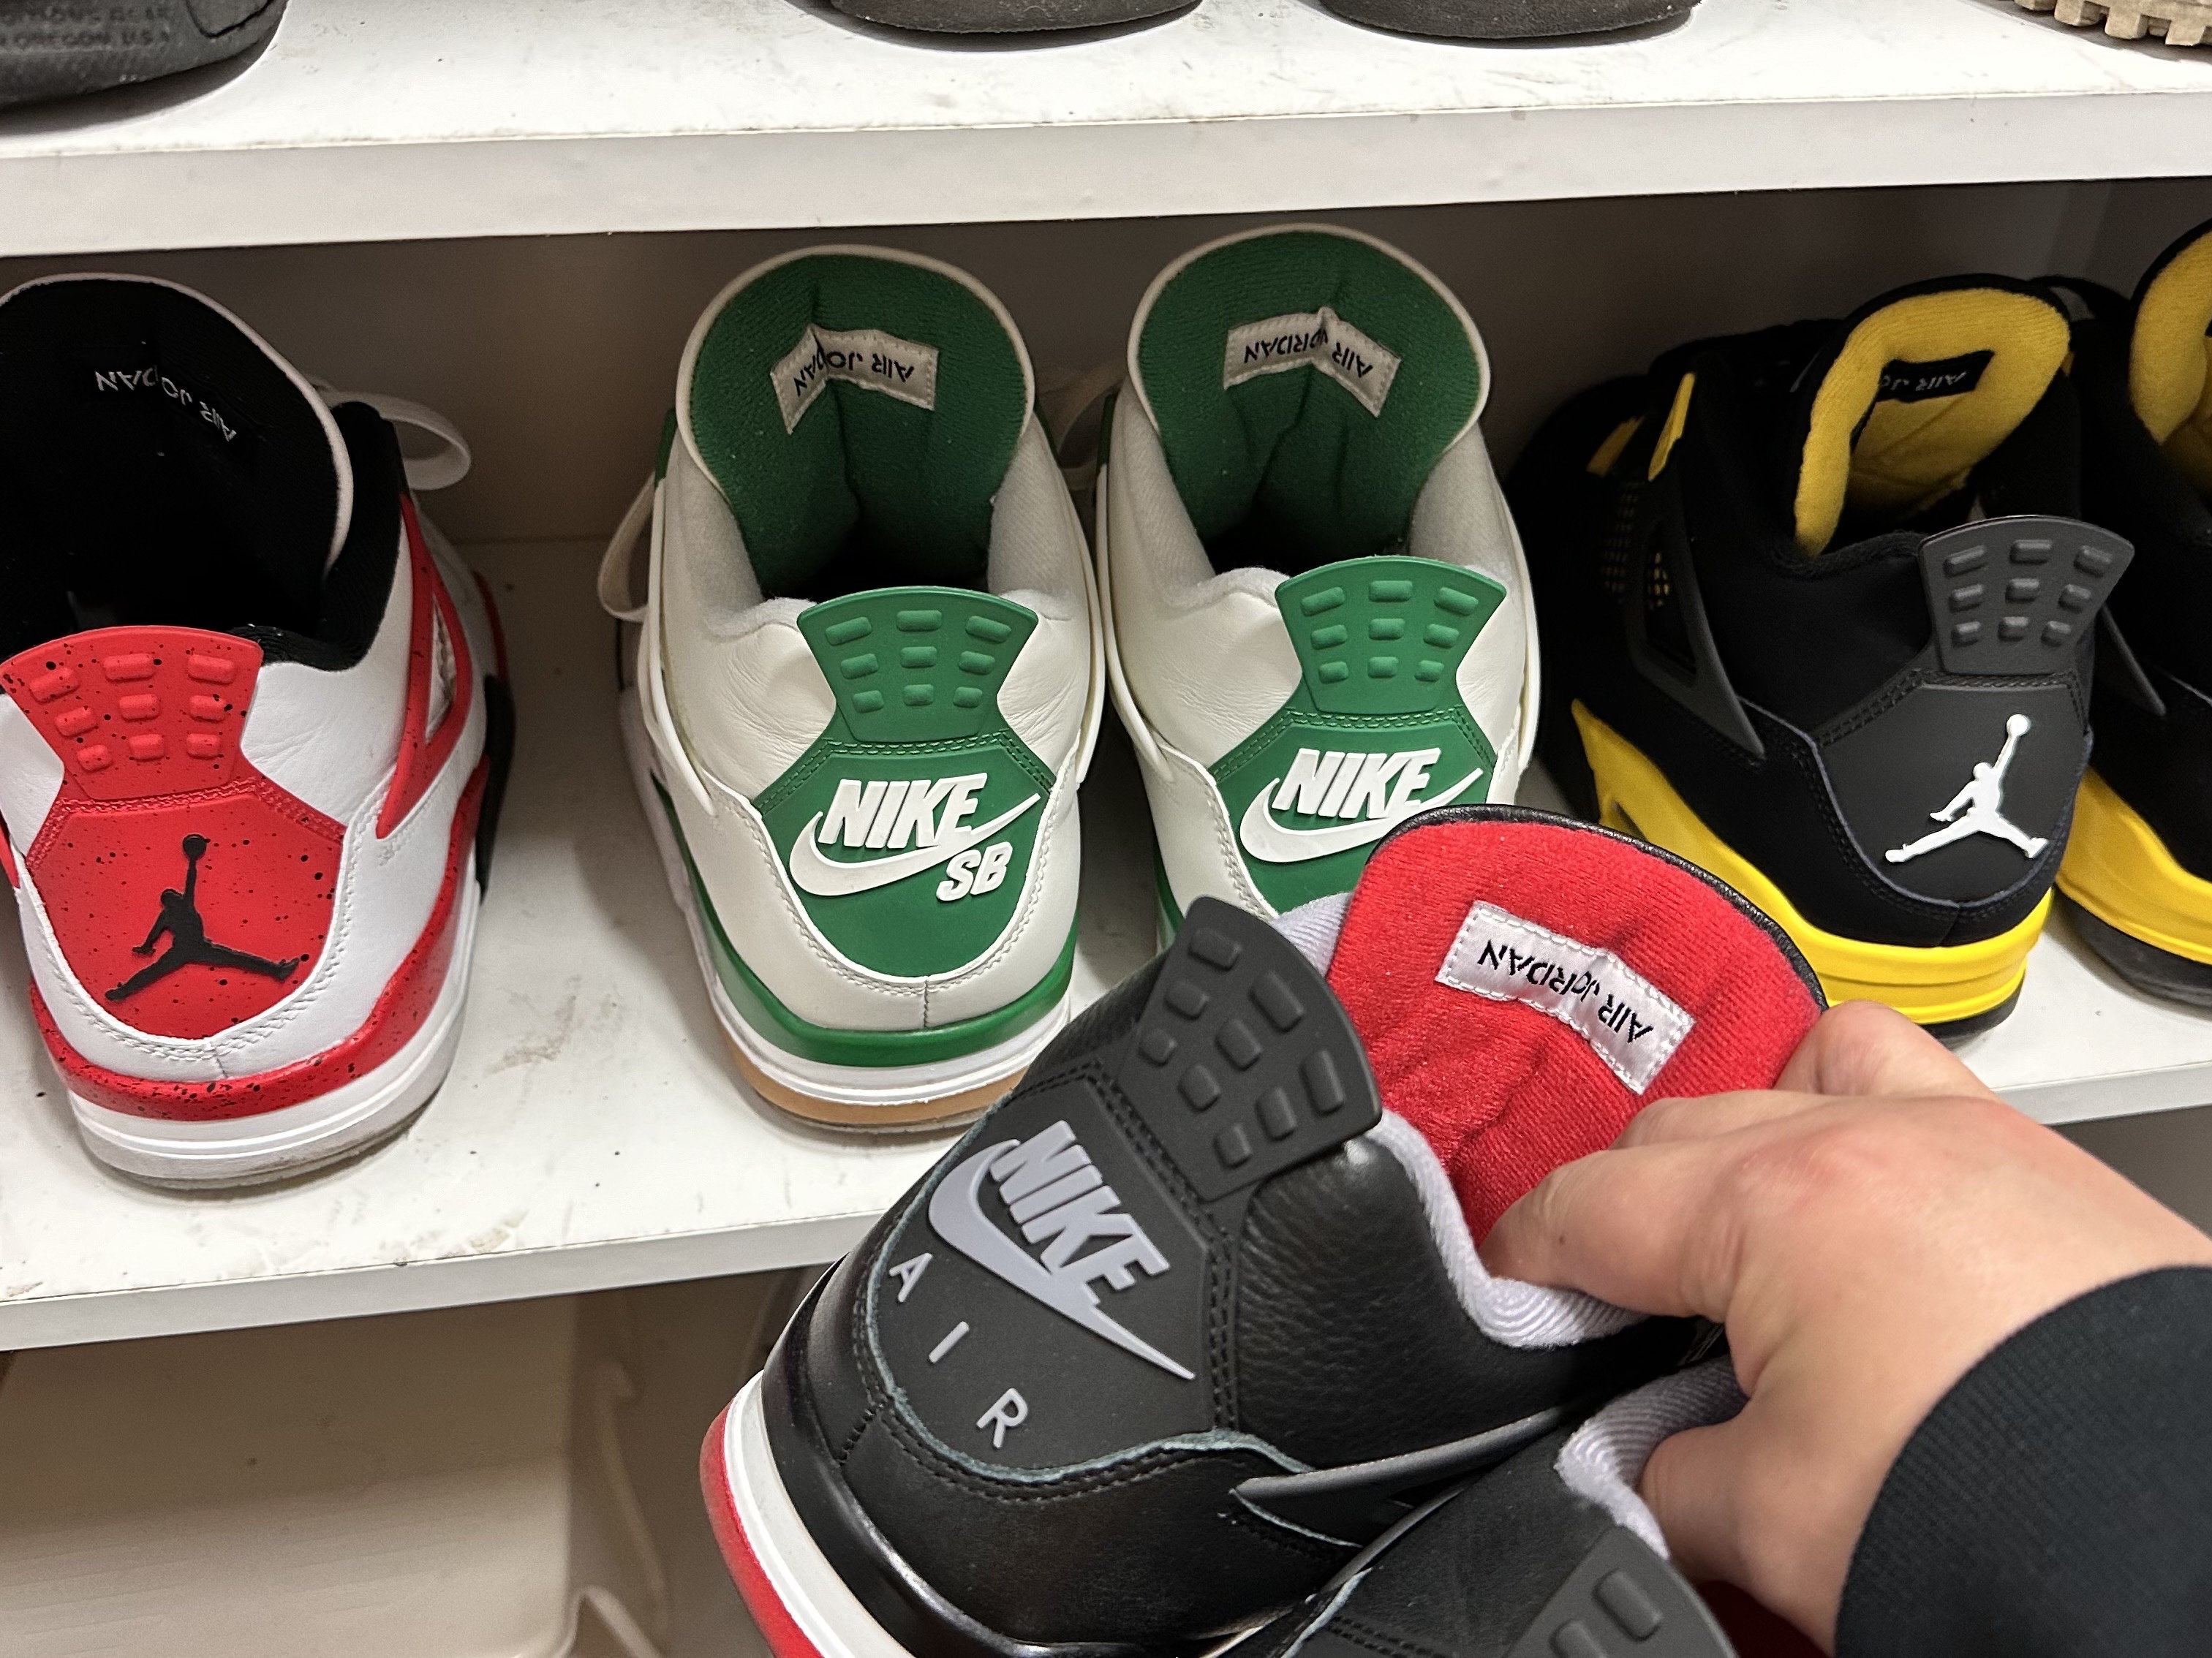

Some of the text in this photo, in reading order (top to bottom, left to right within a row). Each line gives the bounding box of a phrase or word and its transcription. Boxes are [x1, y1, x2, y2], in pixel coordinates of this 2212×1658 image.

[793, 347, 914, 397] AIR JODAN
[1332, 342, 1373, 378] AIR
[1914, 371, 1968, 392] AIR
[94, 366, 238, 442] AIR JODAN
[818, 772, 988, 849] NIKE
[1271, 747, 1442, 819] NIKE
[935, 841, 1013, 901] SB
[1477, 939, 1654, 1043] AIR JORDAN
[989, 1119, 1171, 1305] NIKE
